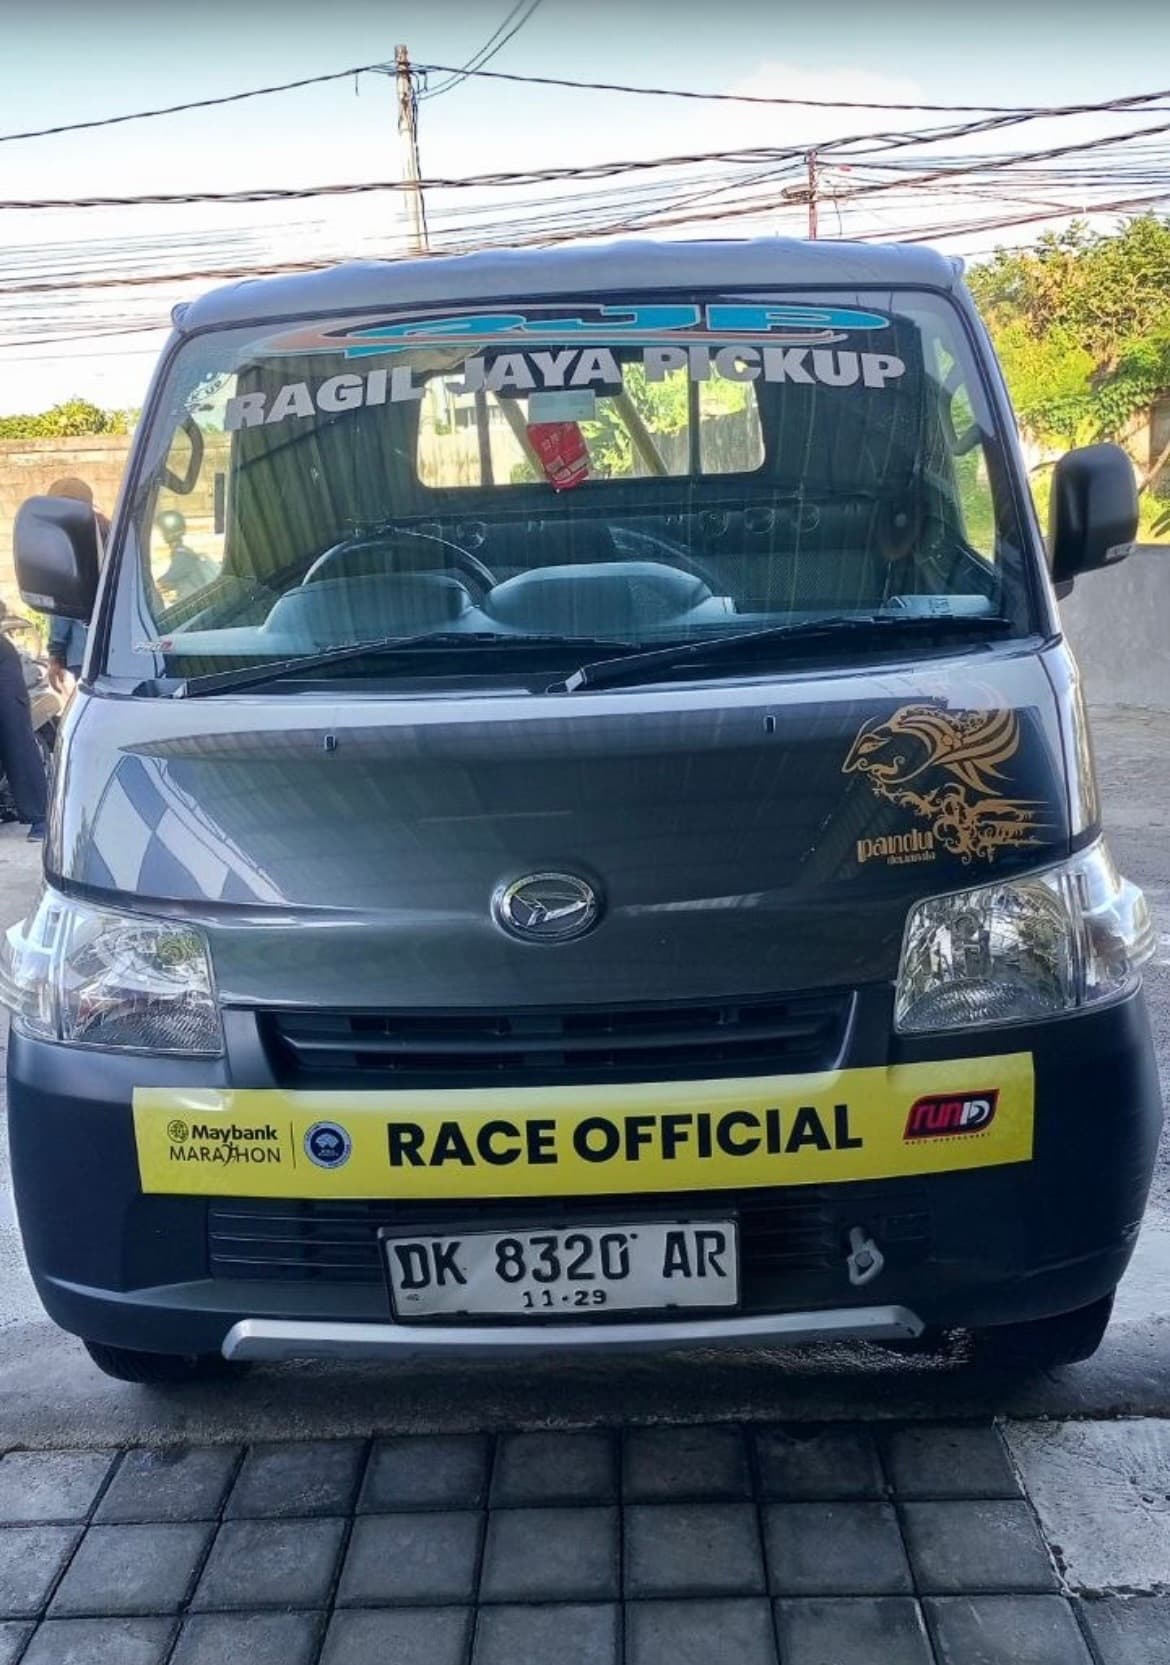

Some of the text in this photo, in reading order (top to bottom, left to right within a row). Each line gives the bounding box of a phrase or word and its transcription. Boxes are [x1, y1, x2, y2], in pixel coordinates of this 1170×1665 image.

[224, 345, 906, 432] RAGIL JAYA PICKUP
[857, 828, 933, 862] pandu
[169, 1143, 282, 1166] MARATHON
[192, 1124, 279, 1143] Maybank
[387, 1120, 558, 1167] RACE
[573, 1104, 863, 1162] OFFICIAL
[394, 1230, 727, 1289] DK 8320 AR
